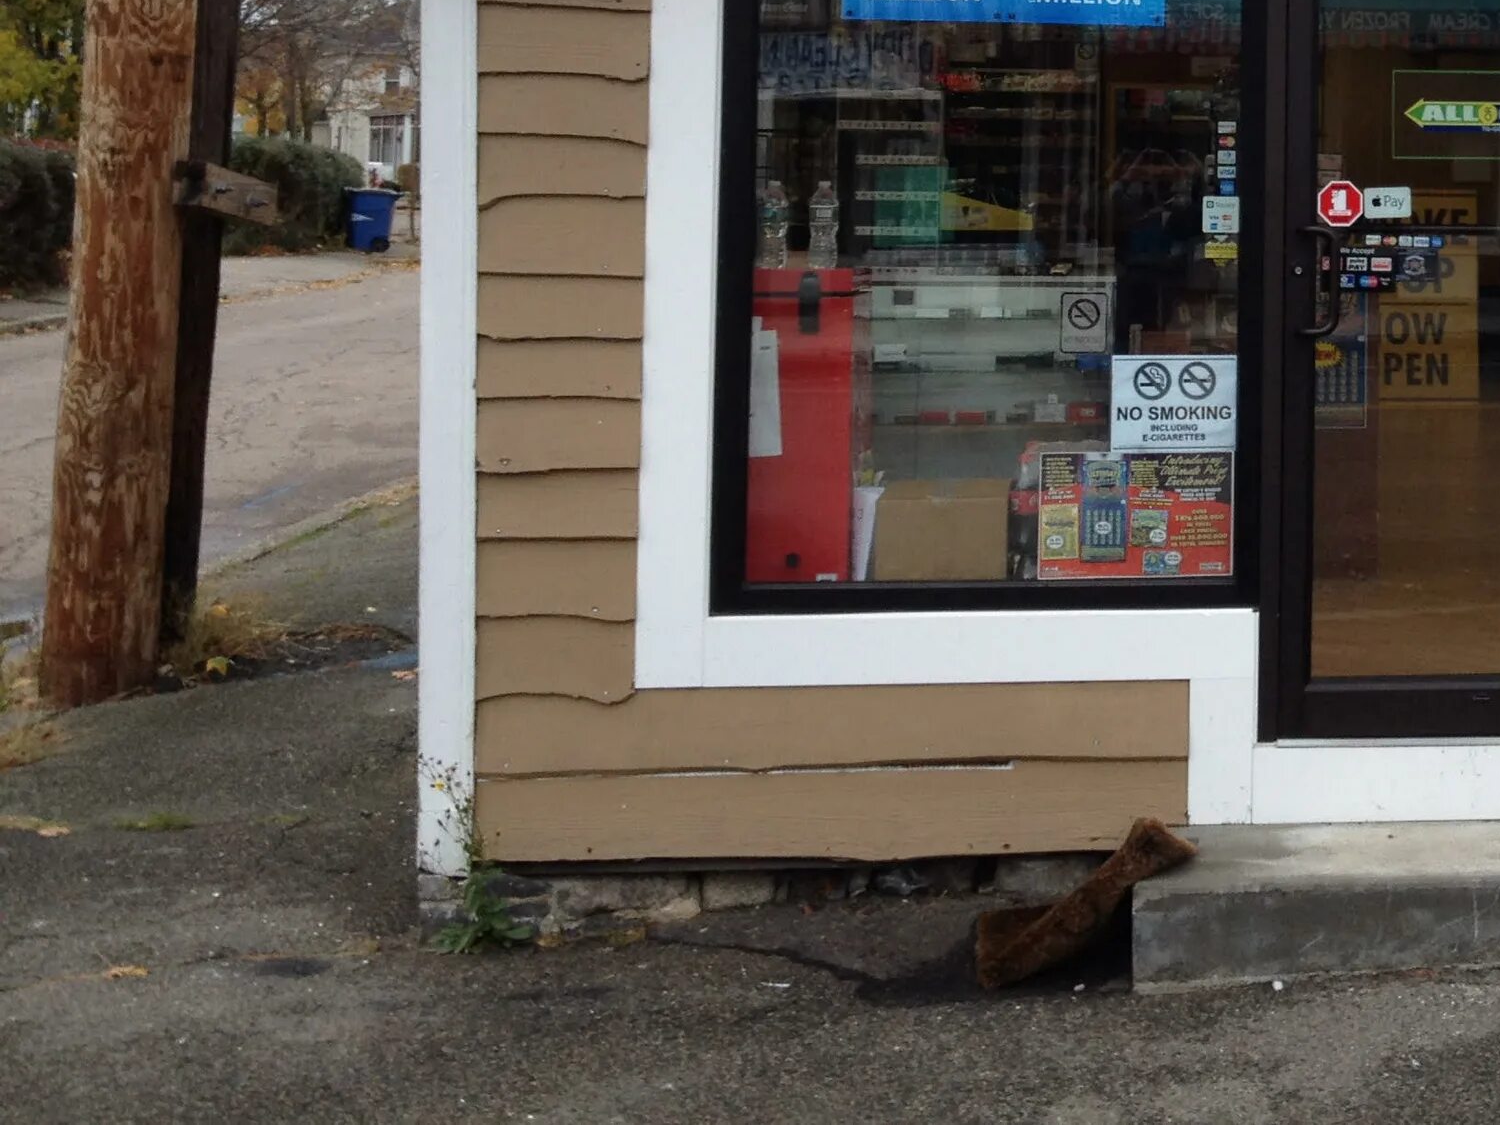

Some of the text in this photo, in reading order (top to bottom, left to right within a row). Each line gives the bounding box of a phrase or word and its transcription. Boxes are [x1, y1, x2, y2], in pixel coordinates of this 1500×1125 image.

[1421, 104, 1479, 122] ALL
[1383, 195, 1405, 210] Pay
[1116, 405, 1232, 421] NO SMOKING
[1150, 423, 1199, 432] INCLUDING
[1142, 433, 1206, 442] E-CIGARETTES
